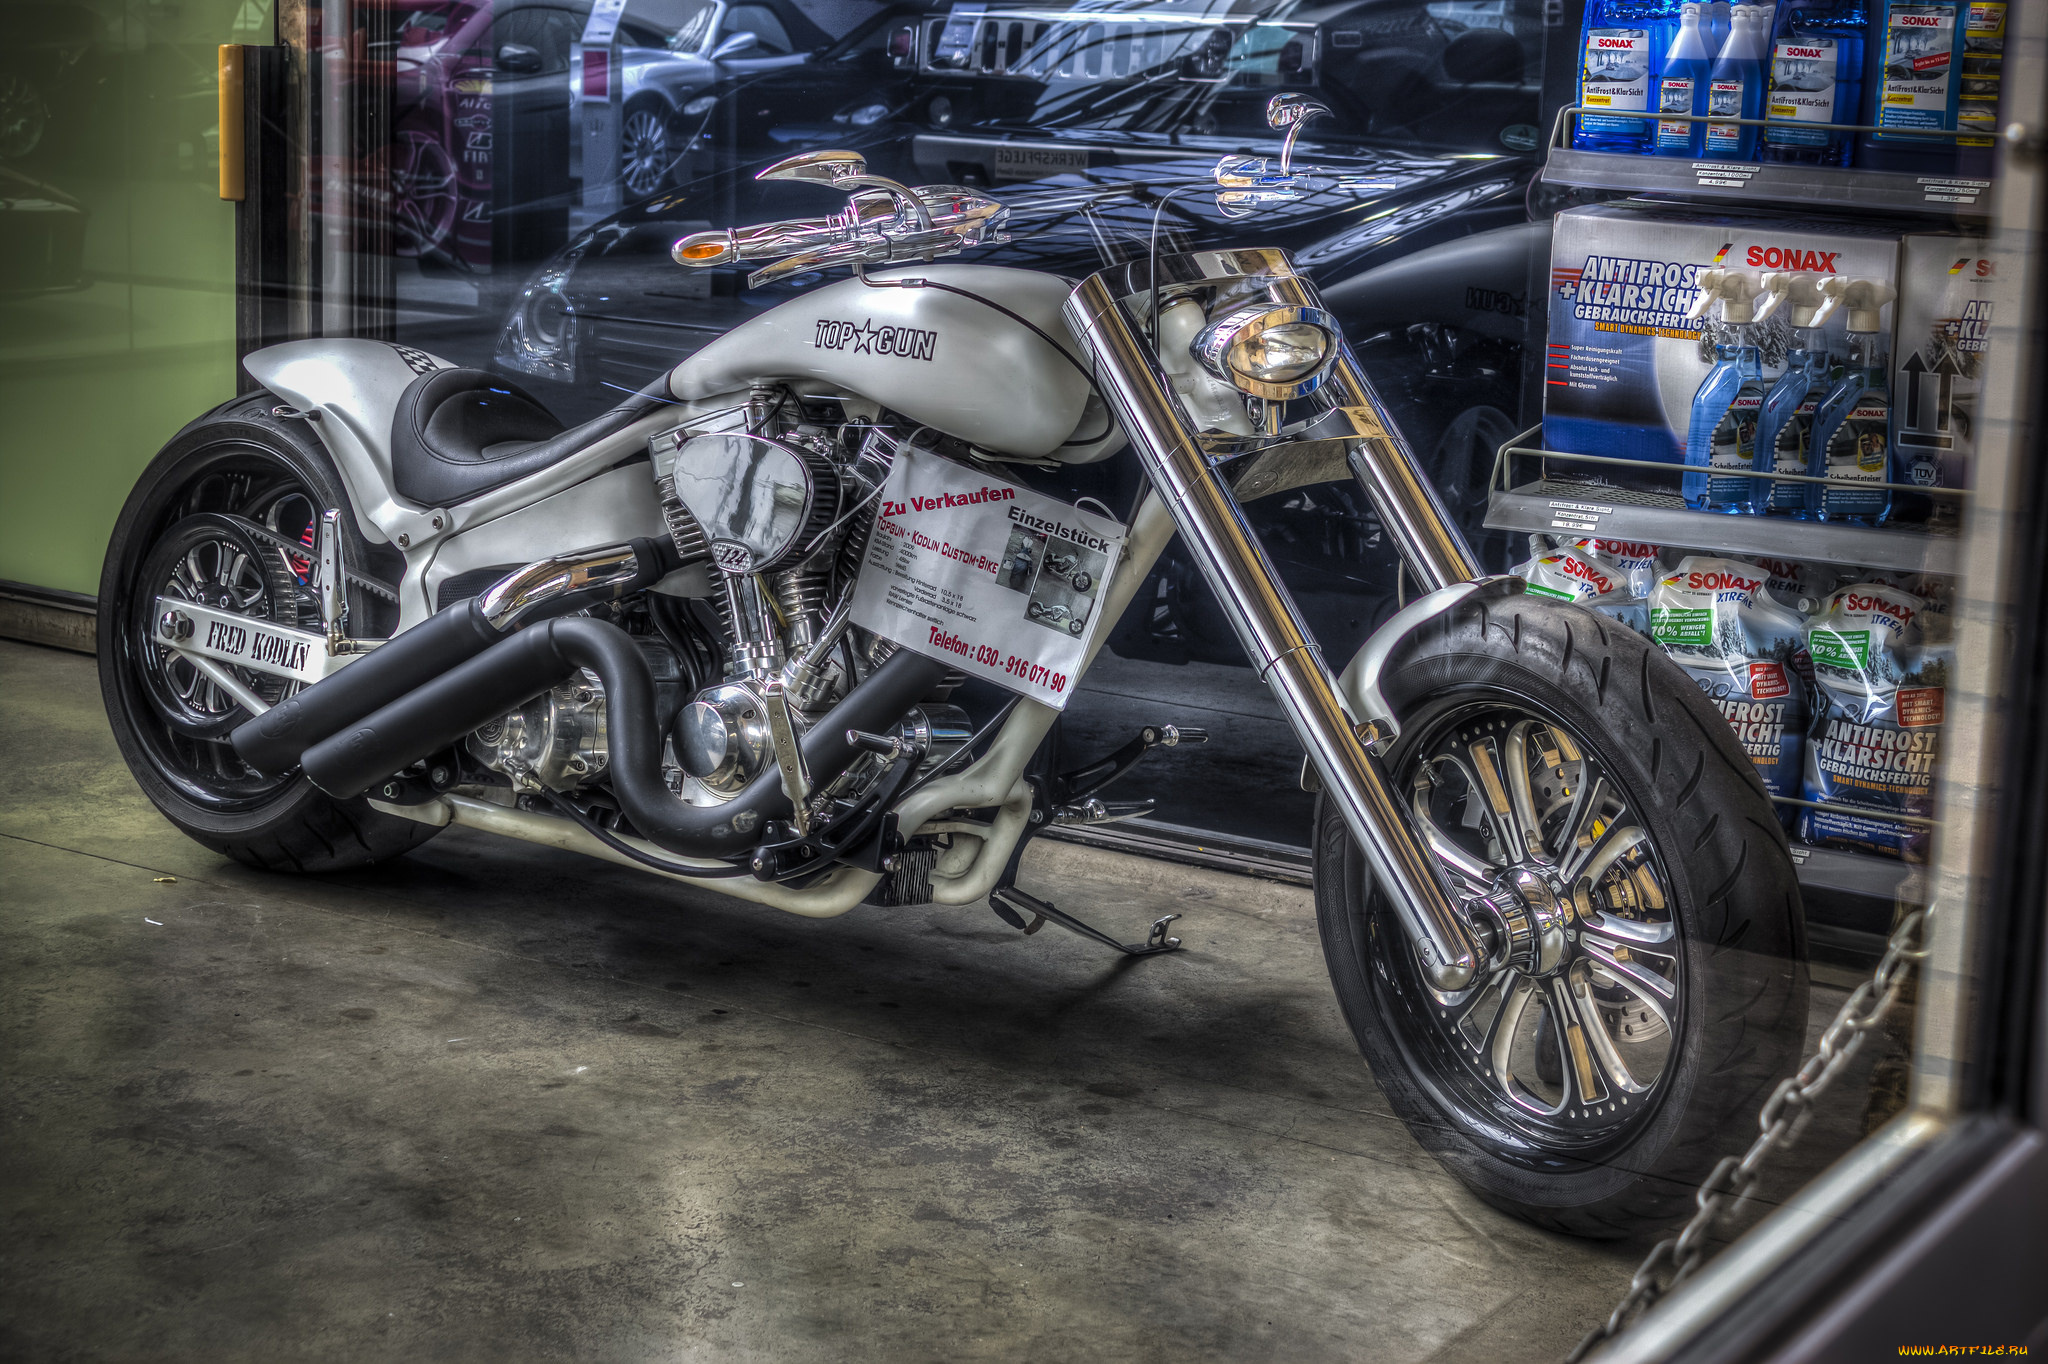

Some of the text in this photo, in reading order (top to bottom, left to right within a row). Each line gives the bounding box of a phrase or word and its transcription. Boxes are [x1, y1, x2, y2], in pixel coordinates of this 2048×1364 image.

[1902, 16, 1939, 26] SONAX
[1598, 38, 1633, 48] SONAX
[1786, 47, 1822, 58] SONAX
[1746, 246, 1837, 274] SONAX
[1574, 304, 1704, 330] GEBRAUCHSFERTIG
[815, 319, 938, 361] TOP GUN
[1594, 322, 1701, 341] SMART DYNAMICS-TECHNOLOGY
[1585, 345, 1623, 355] Reinigungskraft
[1577, 382, 1597, 390] Glycerin
[1856, 409, 1885, 417] SONAX
[882, 487, 1016, 517] Zu Verkaufen
[876, 516, 906, 539] TOPGUN
[911, 530, 940, 553] KODLIN
[1008, 505, 1110, 554] Einzelstück
[720, 548, 748, 566] 124
[1688, 572, 1762, 595] SONAX
[1716, 592, 1754, 610] XTREME
[1847, 593, 1916, 626] SONAX
[206, 620, 311, 672] FRED KODLIN
[928, 626, 968, 657] Telefon
[976, 645, 1000, 667] 030
[1006, 656, 1029, 679] 916
[1029, 664, 1049, 687] 071
[1050, 672, 1066, 693] 90
[1914, 699, 1934, 707] SMART
[1903, 713, 1941, 722] TECHNOLOGY!
[1826, 719, 1937, 753] ANTIFROST
[1814, 738, 1936, 773] +KLARSICHT
[1820, 757, 1931, 786] GEBRAUCHSFERTIG
[1833, 774, 1853, 786] SMART
